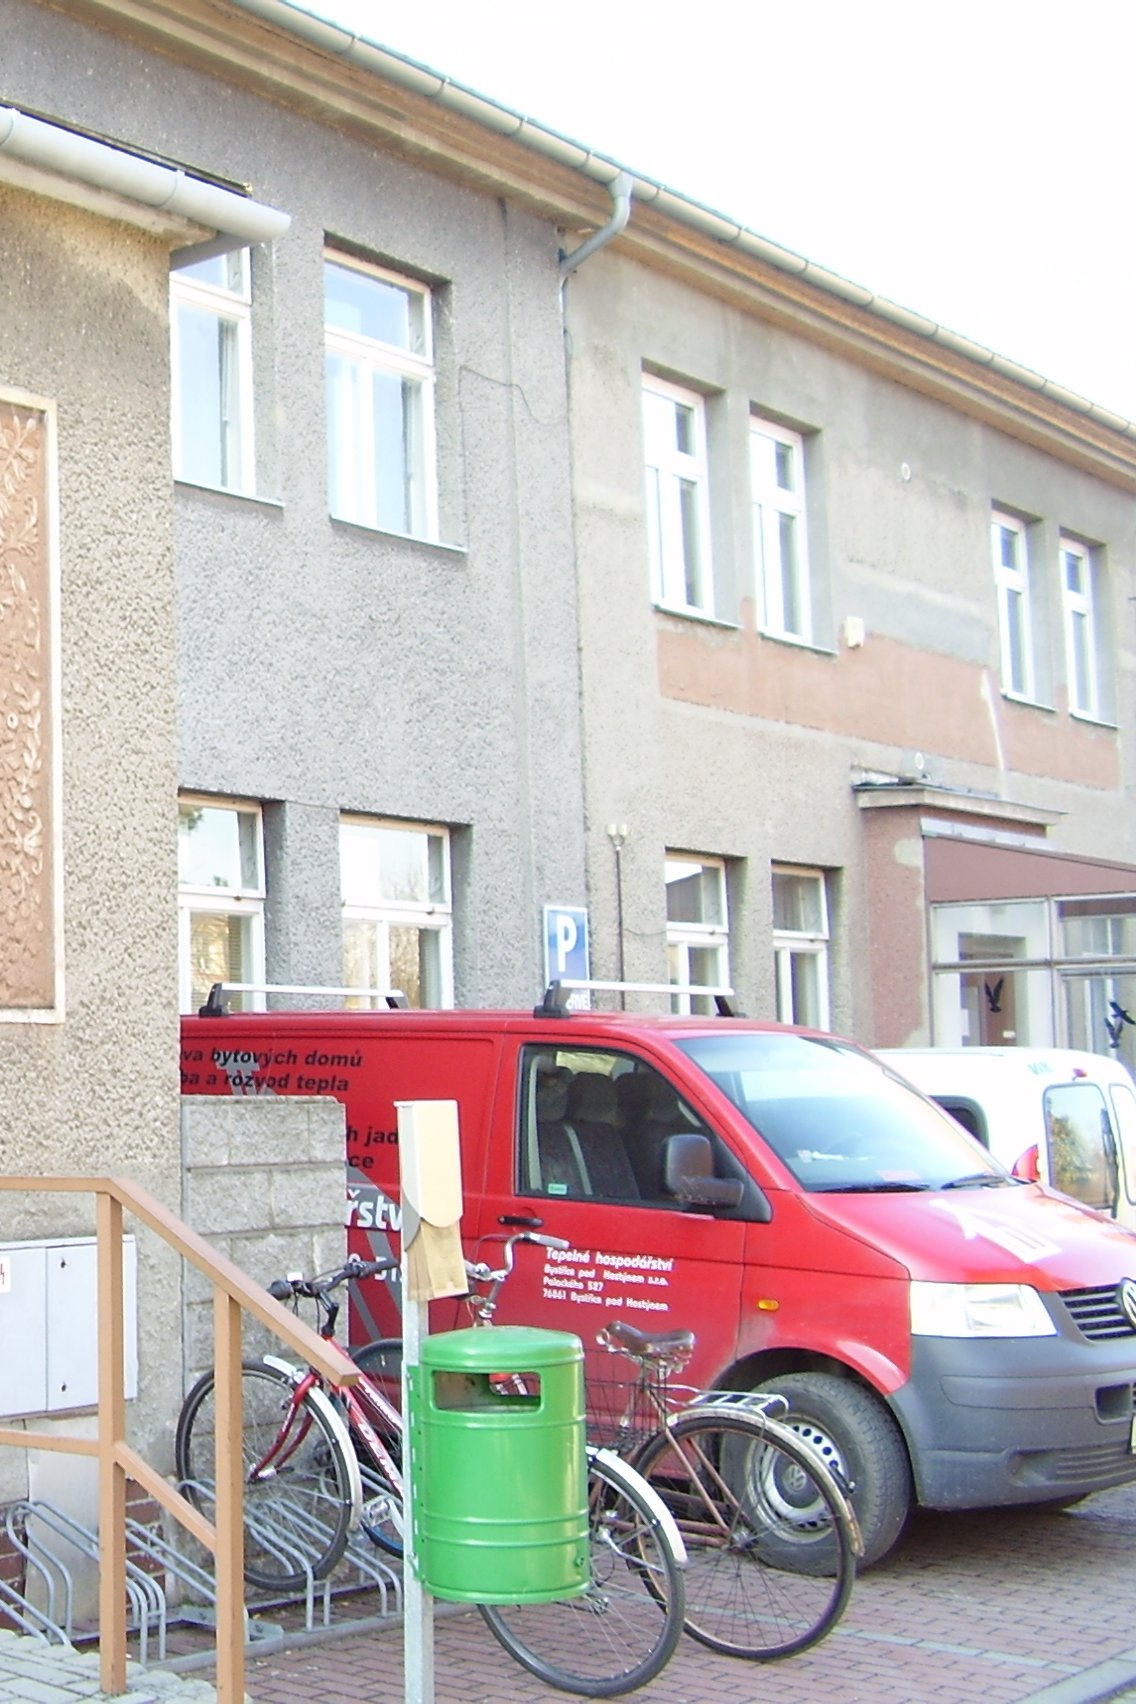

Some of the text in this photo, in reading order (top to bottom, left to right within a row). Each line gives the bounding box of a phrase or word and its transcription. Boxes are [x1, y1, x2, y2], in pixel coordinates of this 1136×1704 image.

[556, 914, 578, 972] P
[210, 1047, 297, 1067] bytových
[206, 1075, 217, 1085] a
[224, 1073, 290, 1089] rozvod
[297, 1075, 349, 1093] tepla
[346, 1188, 402, 1231] řstv
[546, 1246, 674, 1272] Tepelné hospodářství
[578, 1269, 596, 1279] pod
[605, 1297, 623, 1307] pod
